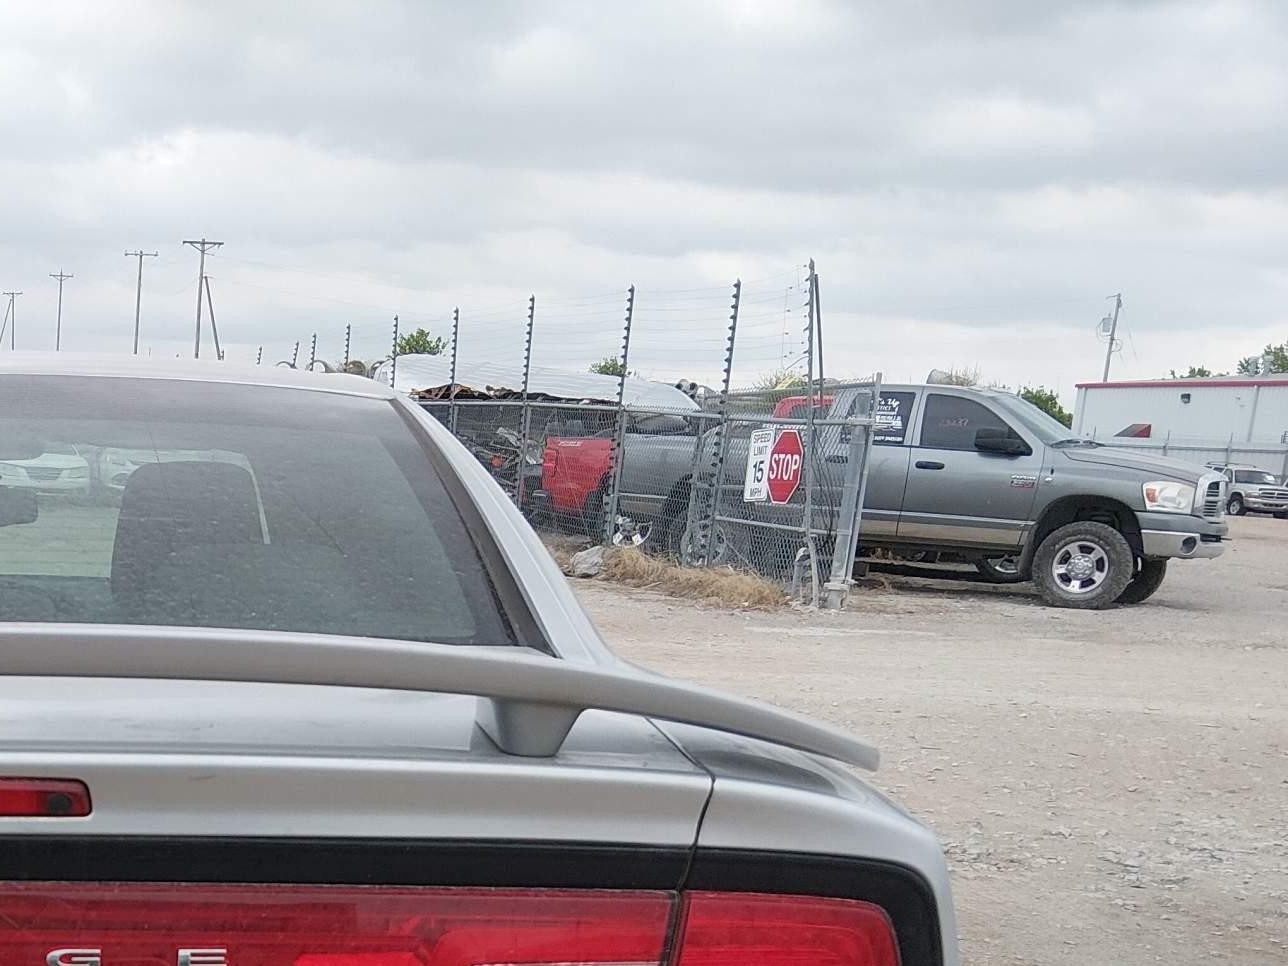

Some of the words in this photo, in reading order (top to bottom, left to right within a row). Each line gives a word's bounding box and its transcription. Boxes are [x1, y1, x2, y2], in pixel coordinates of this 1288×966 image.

[753, 432, 771, 443] SPEED
[754, 446, 768, 456] LIMIT
[753, 460, 764, 483] 15
[769, 453, 800, 480] STOP
[749, 487, 762, 497] MPH
